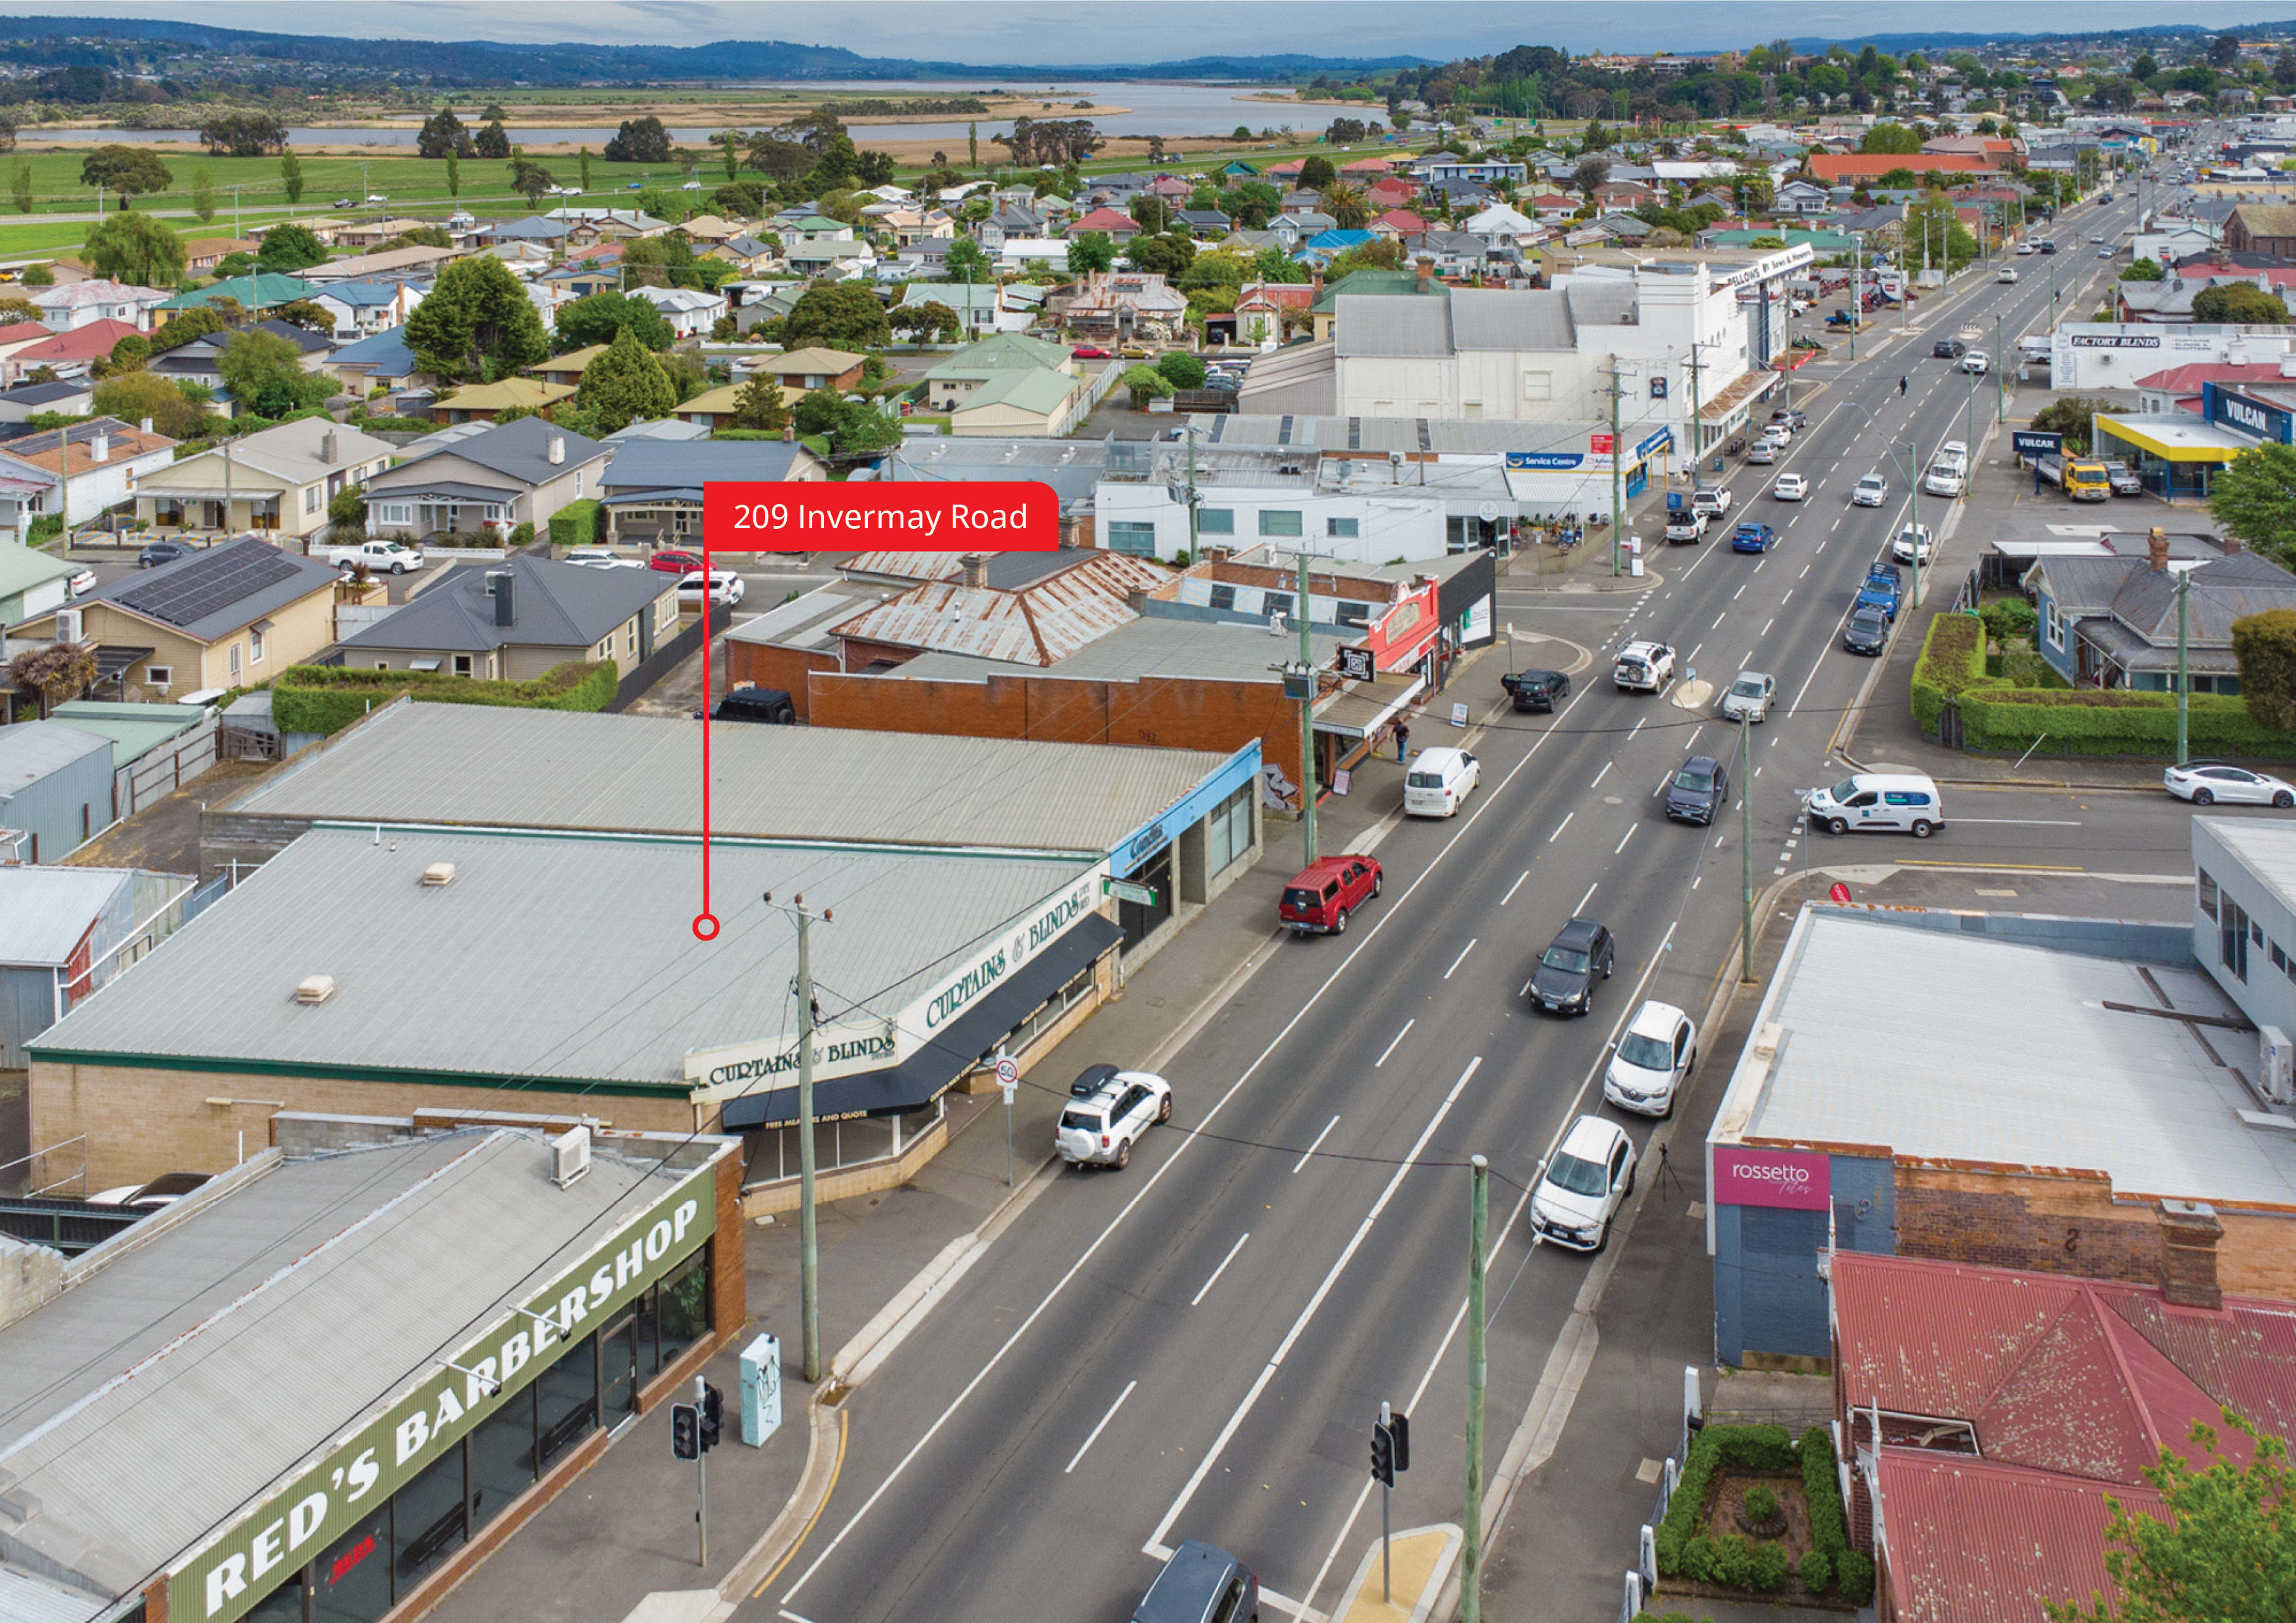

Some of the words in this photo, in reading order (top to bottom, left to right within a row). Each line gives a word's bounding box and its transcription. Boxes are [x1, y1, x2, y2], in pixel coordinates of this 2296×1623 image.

[2073, 336, 2118, 346] FACTORY
[2119, 337, 2159, 347] BLINDS
[1525, 457, 1551, 465] Service
[1551, 457, 1577, 466] Centre
[926, 947, 1005, 1028] CURTAINS
[1029, 891, 1079, 952] BLINDS
[827, 1036, 896, 1063] BLINDS
[1000, 1065, 1014, 1078] 50
[765, 1120, 783, 1130] FREE
[821, 1113, 840, 1122] AND
[841, 1109, 867, 1120] QUOTE
[1732, 1164, 1809, 1183] rossetto
[1768, 1179, 1812, 1195] Tiles
[206, 1448, 380, 1618] RED'S
[396, 1200, 697, 1467] BARBERSHOP
